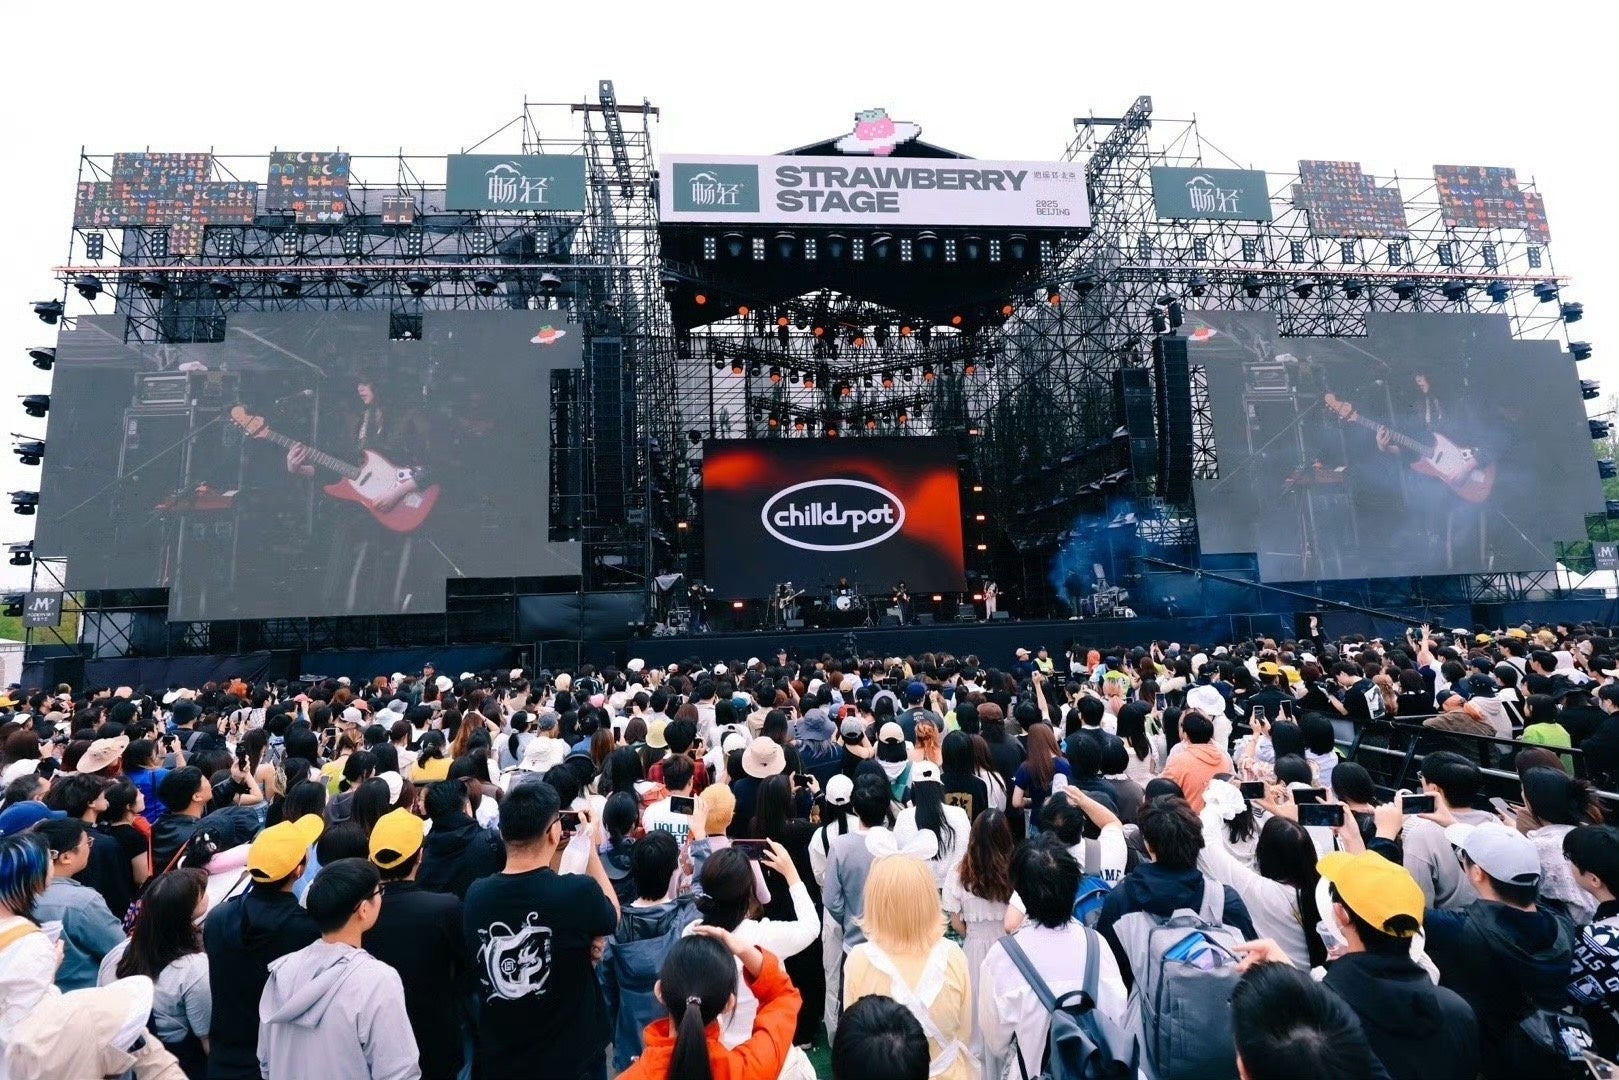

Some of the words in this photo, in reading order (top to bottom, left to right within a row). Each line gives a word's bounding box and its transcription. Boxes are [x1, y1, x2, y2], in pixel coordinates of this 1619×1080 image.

[487, 174, 549, 204] 畅轻
[775, 165, 1028, 191] STRAWBERRY
[691, 181, 742, 205] 畅轻
[775, 189, 900, 213] STAGE
[1035, 199, 1059, 208] 2025
[1189, 186, 1243, 212] 畅轻
[1036, 207, 1071, 216] BEIJING
[773, 502, 894, 533] chilldspot
